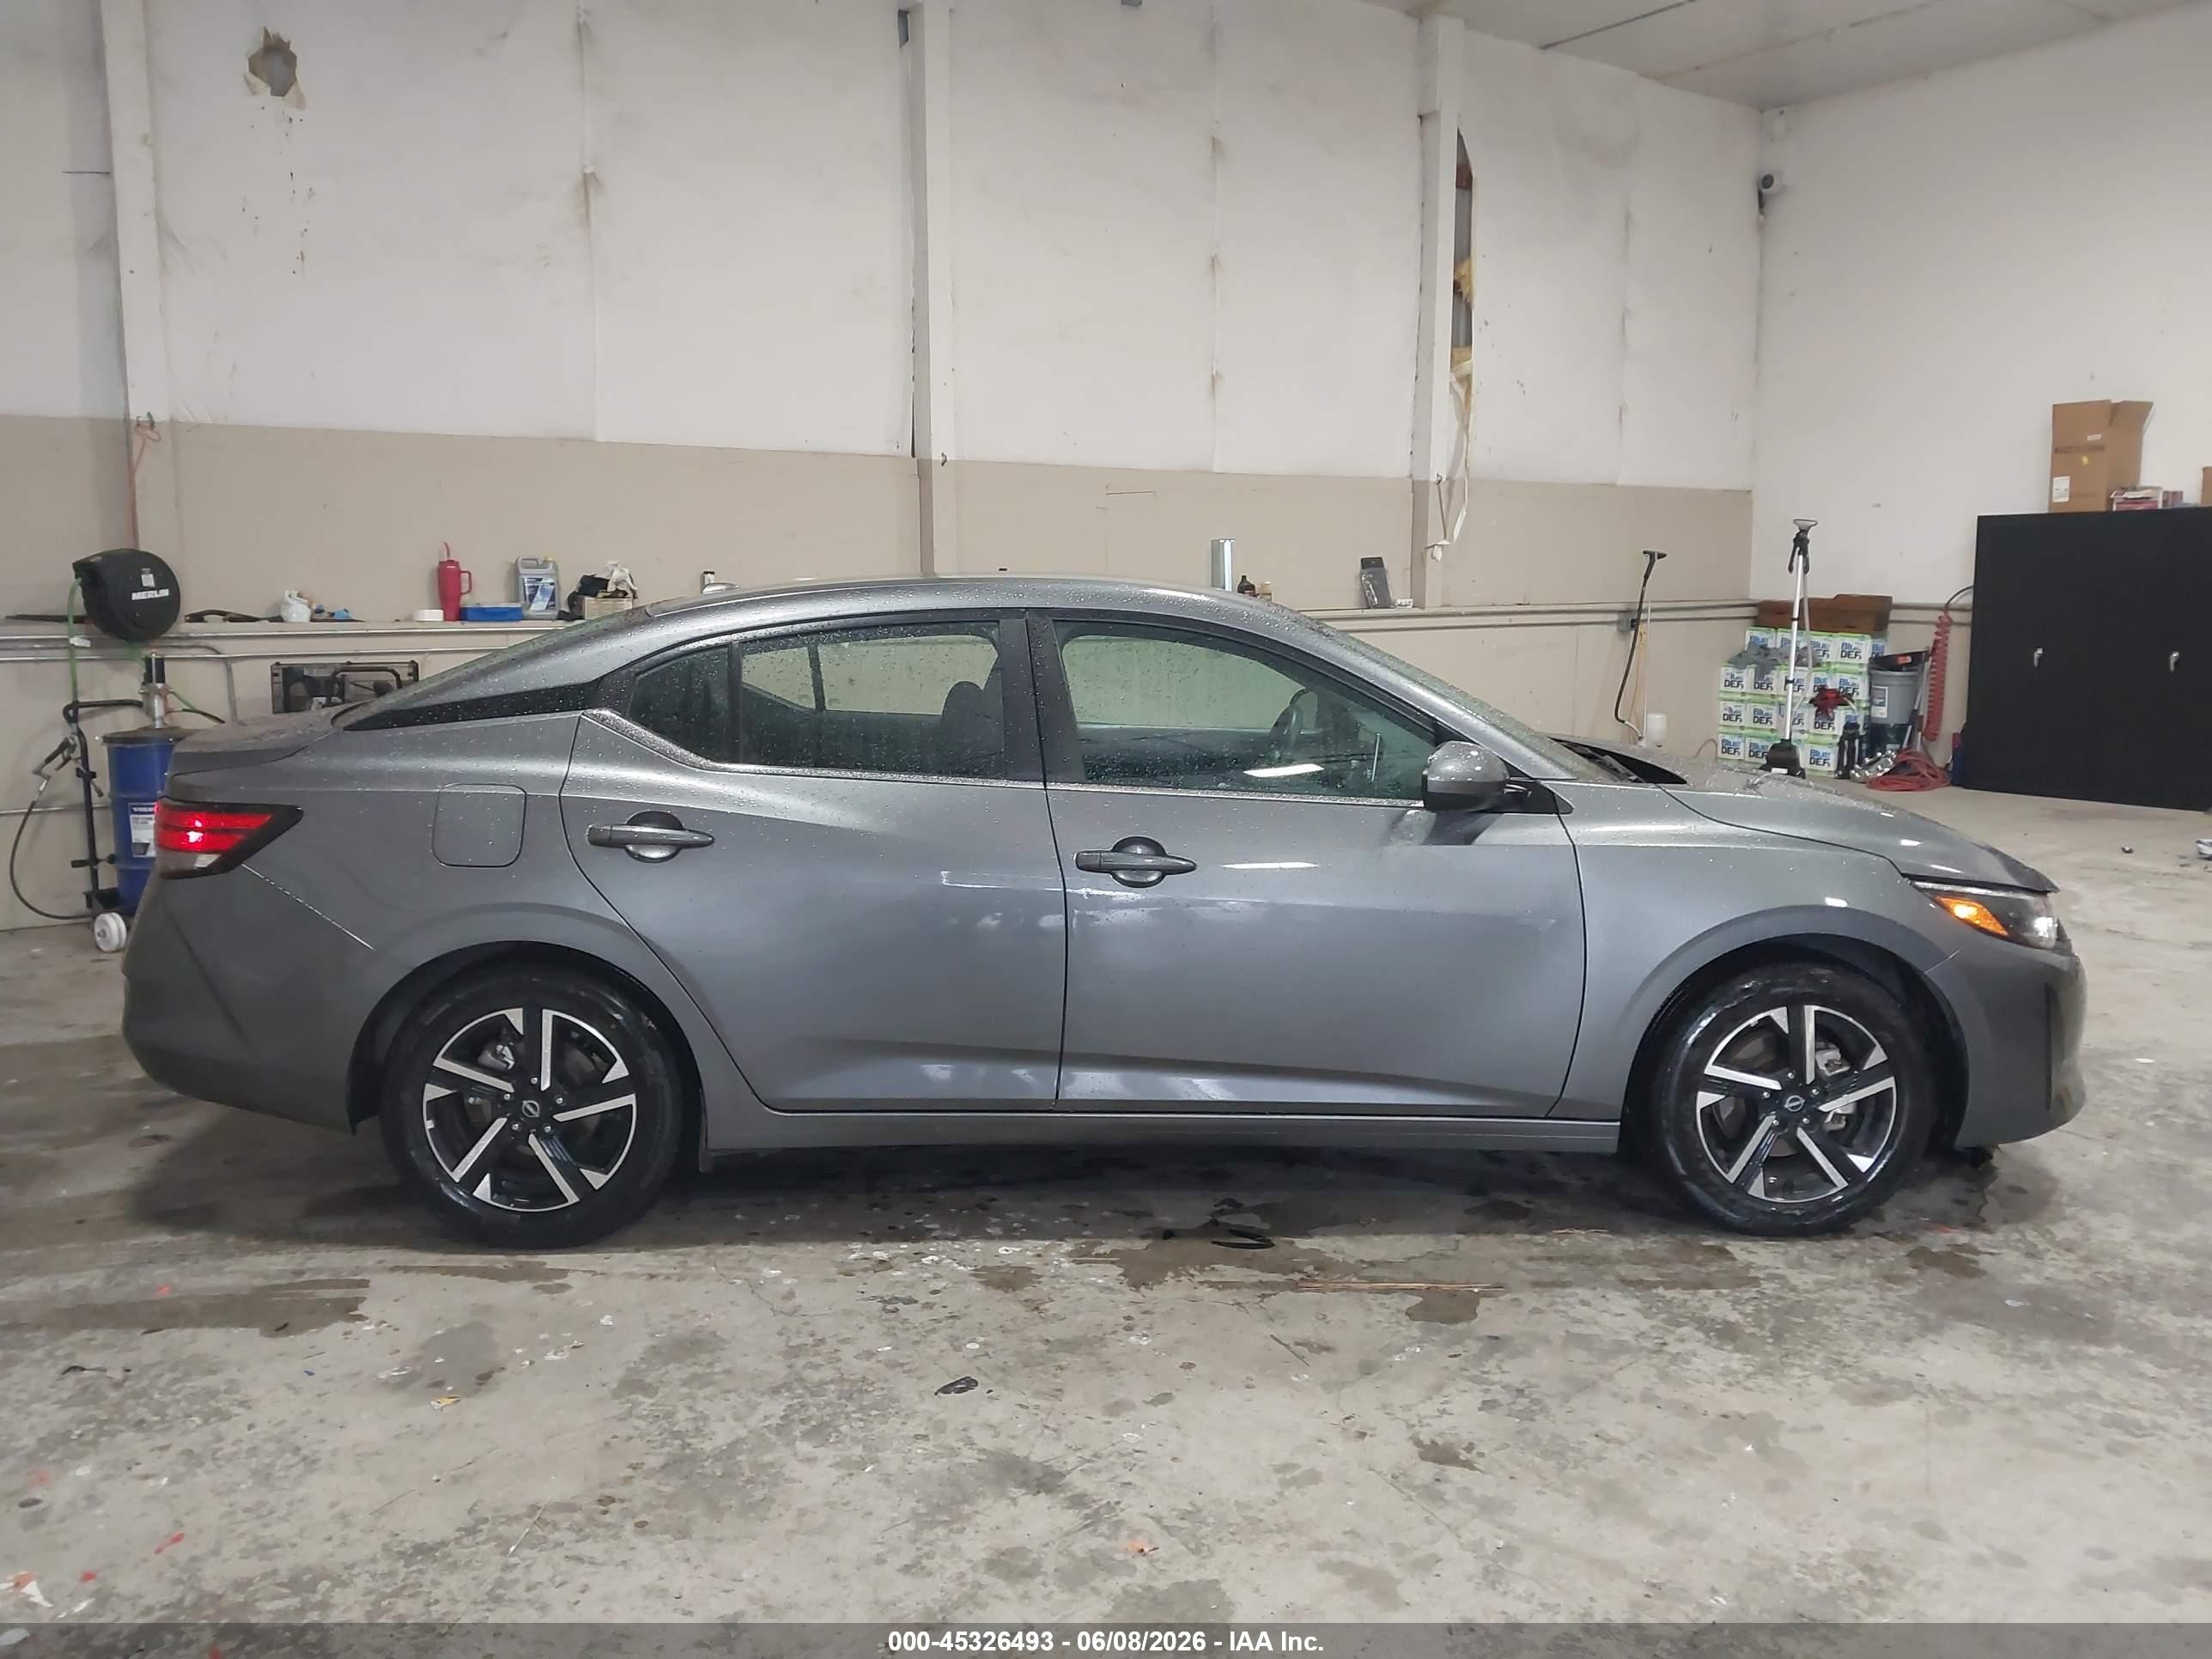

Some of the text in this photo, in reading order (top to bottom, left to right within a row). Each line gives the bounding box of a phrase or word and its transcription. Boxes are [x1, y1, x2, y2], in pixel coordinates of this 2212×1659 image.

[1840, 650, 1862, 659] DEF
[1724, 679, 1743, 689] DEF
[1753, 682, 1773, 690] DEF
[1723, 714, 1742, 722] DEF
[1753, 716, 1772, 726] DEF
[1814, 721, 1835, 730] DEF
[1721, 746, 1741, 756] DEF
[1809, 757, 1831, 766] DEF
